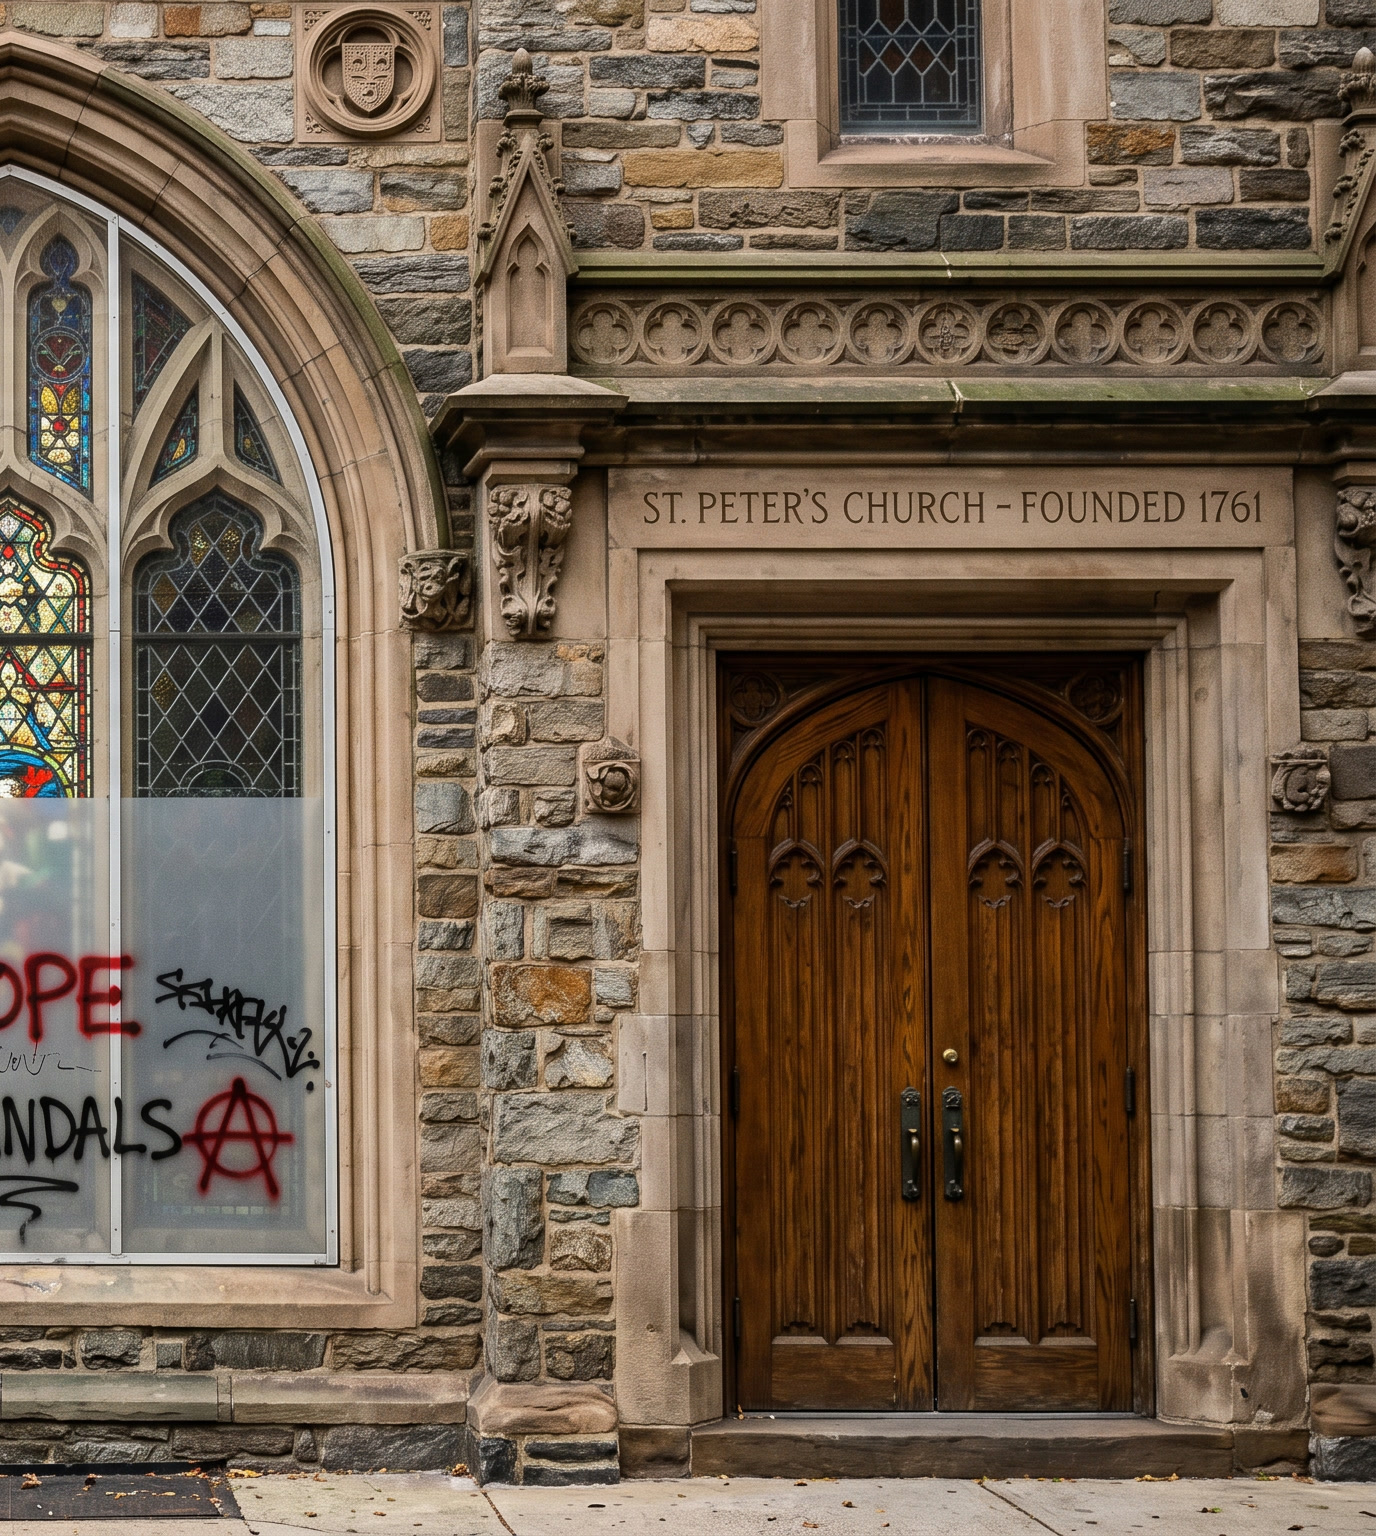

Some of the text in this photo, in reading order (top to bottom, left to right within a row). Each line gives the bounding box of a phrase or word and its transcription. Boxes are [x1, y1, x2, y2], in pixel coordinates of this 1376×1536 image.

[642, 490, 686, 525] ST.
[697, 487, 829, 525] PETER'S
[843, 490, 985, 525] CHURCH
[1021, 490, 1186, 524] FOUNDED
[1199, 489, 1262, 524] 1761
